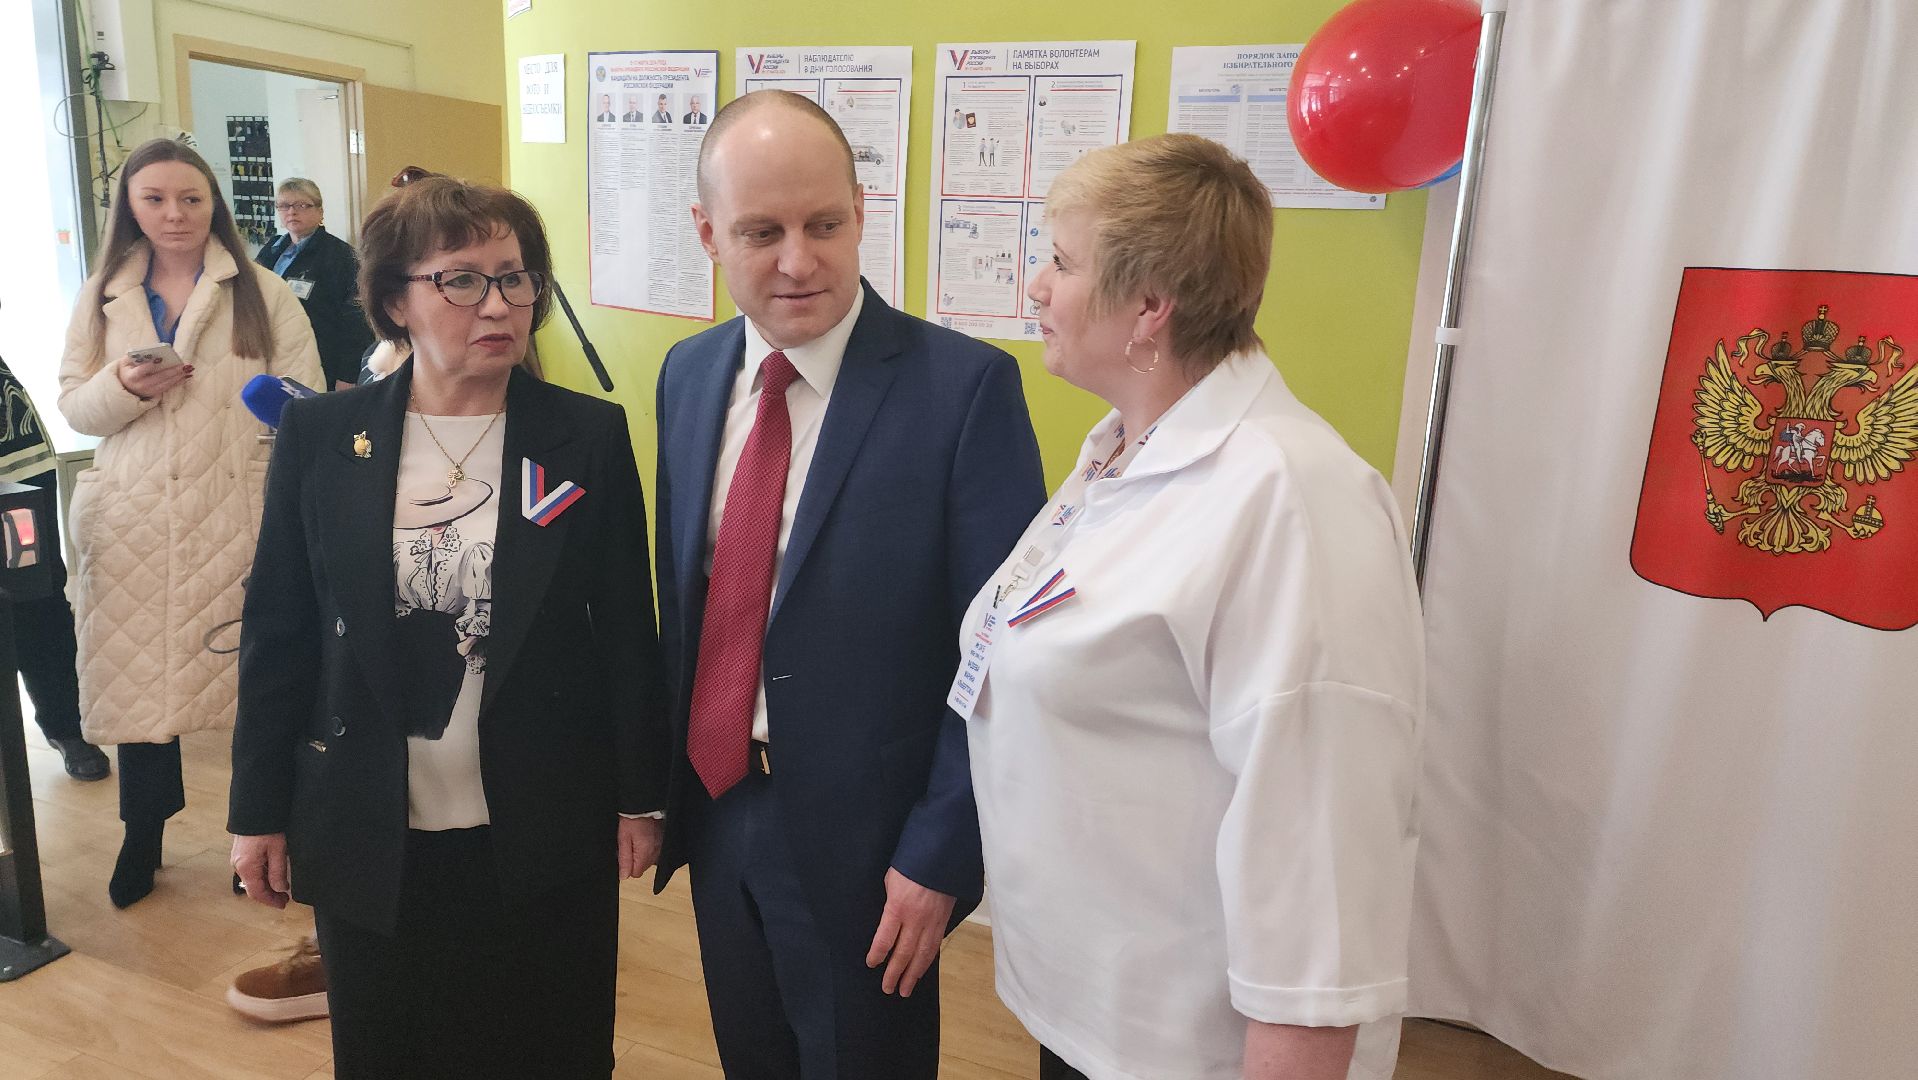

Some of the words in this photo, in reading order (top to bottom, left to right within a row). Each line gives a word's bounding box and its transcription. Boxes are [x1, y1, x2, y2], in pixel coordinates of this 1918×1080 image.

[1012, 50, 1047, 59] ПАМЯТКА
[1049, 49, 1100, 58] ВОЛОНТЕРАМ
[1237, 52, 1275, 60] ПОРЯДОК
[544, 61, 559, 75] ДЛЯ
[804, 65, 809, 73] В
[810, 65, 824, 74] ДНИ
[825, 64, 873, 73] ГОЛОСОВАНИЯ
[1012, 61, 1022, 70] НА
[1024, 60, 1060, 69] ВЫБОРАХ
[1223, 61, 1293, 69] ИЗБИРАТЕЛЬНОГО
[962, 81, 966, 89] 1
